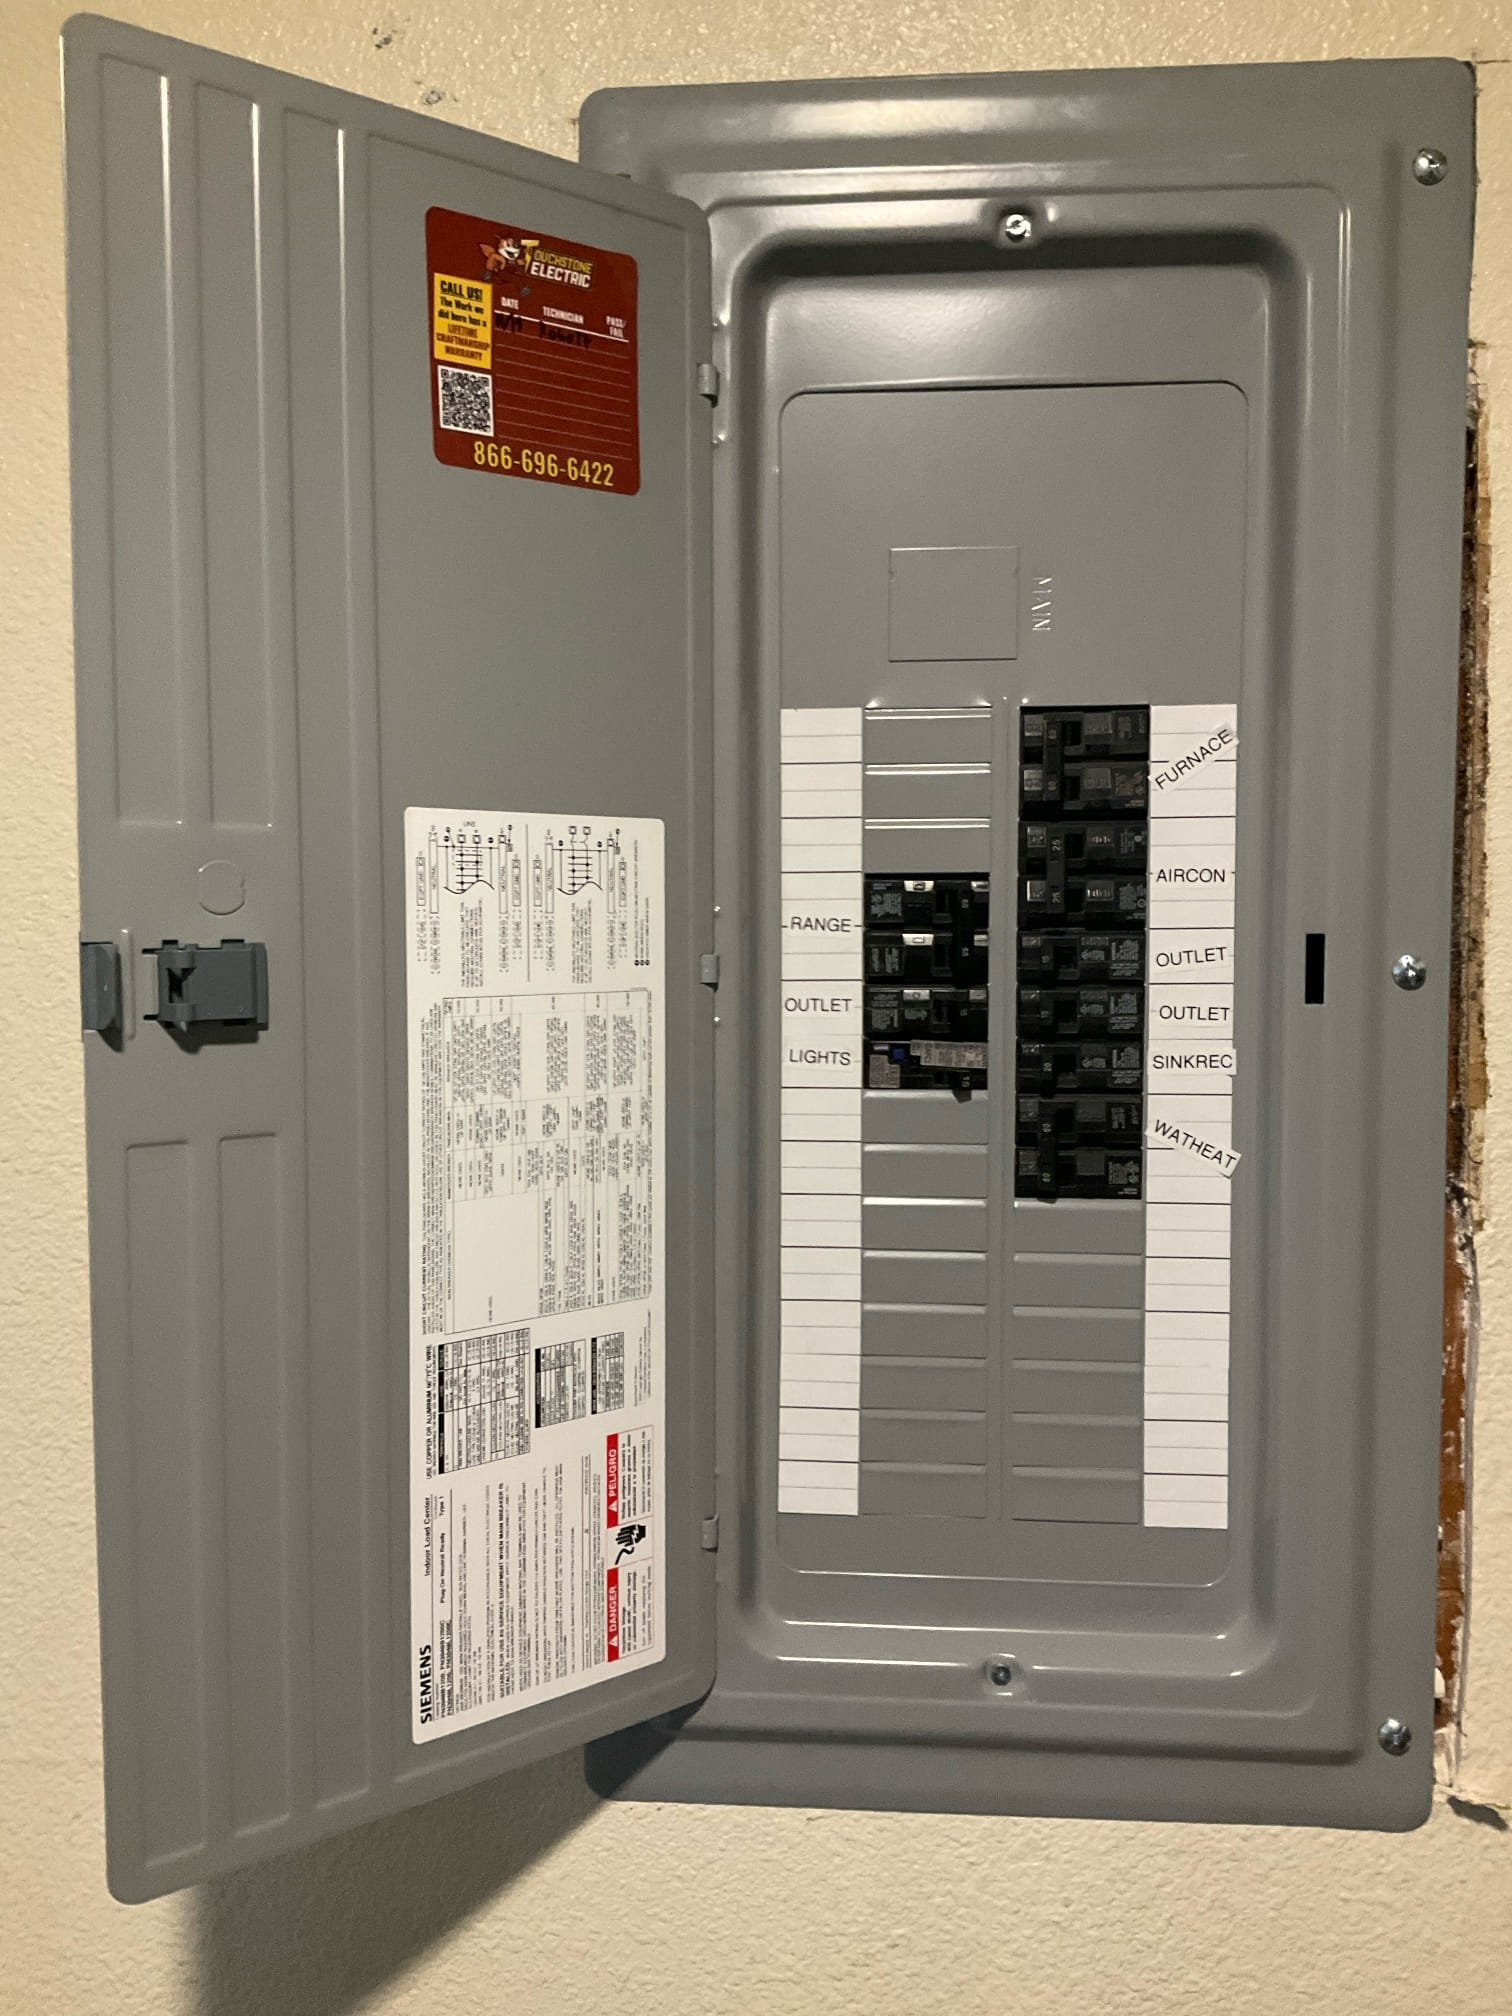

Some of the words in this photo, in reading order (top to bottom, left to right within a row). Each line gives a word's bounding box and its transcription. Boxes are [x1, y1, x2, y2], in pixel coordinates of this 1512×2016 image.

[521, 239, 593, 275] TOUCHSTONE
[530, 261, 591, 288] ELECTRIC
[440, 280, 463, 297] CALL
[466, 286, 483, 302] US!
[501, 297, 519, 310] DATE
[542, 306, 584, 324] TECHNICIAN
[609, 326, 624, 339] FAIL
[473, 441, 614, 487] 866-696-6422
[1154, 728, 1234, 790] FURNACE
[1156, 867, 1226, 885] AIRCON
[790, 917, 852, 934] RANGE
[1155, 946, 1227, 968] OUTLET
[785, 997, 852, 1013] OUTLET
[1159, 1005, 1231, 1022] OUTLET
[789, 1051, 851, 1067] LIGHTS
[1152, 1053, 1233, 1070] SINKREC
[1154, 1119, 1236, 1168] WATHEAT
[608, 1449, 617, 1498] PELIGRO
[423, 1497, 431, 1525] Center
[608, 1586, 617, 1633] DANGER
[419, 1645, 432, 1724] SIEMENS
